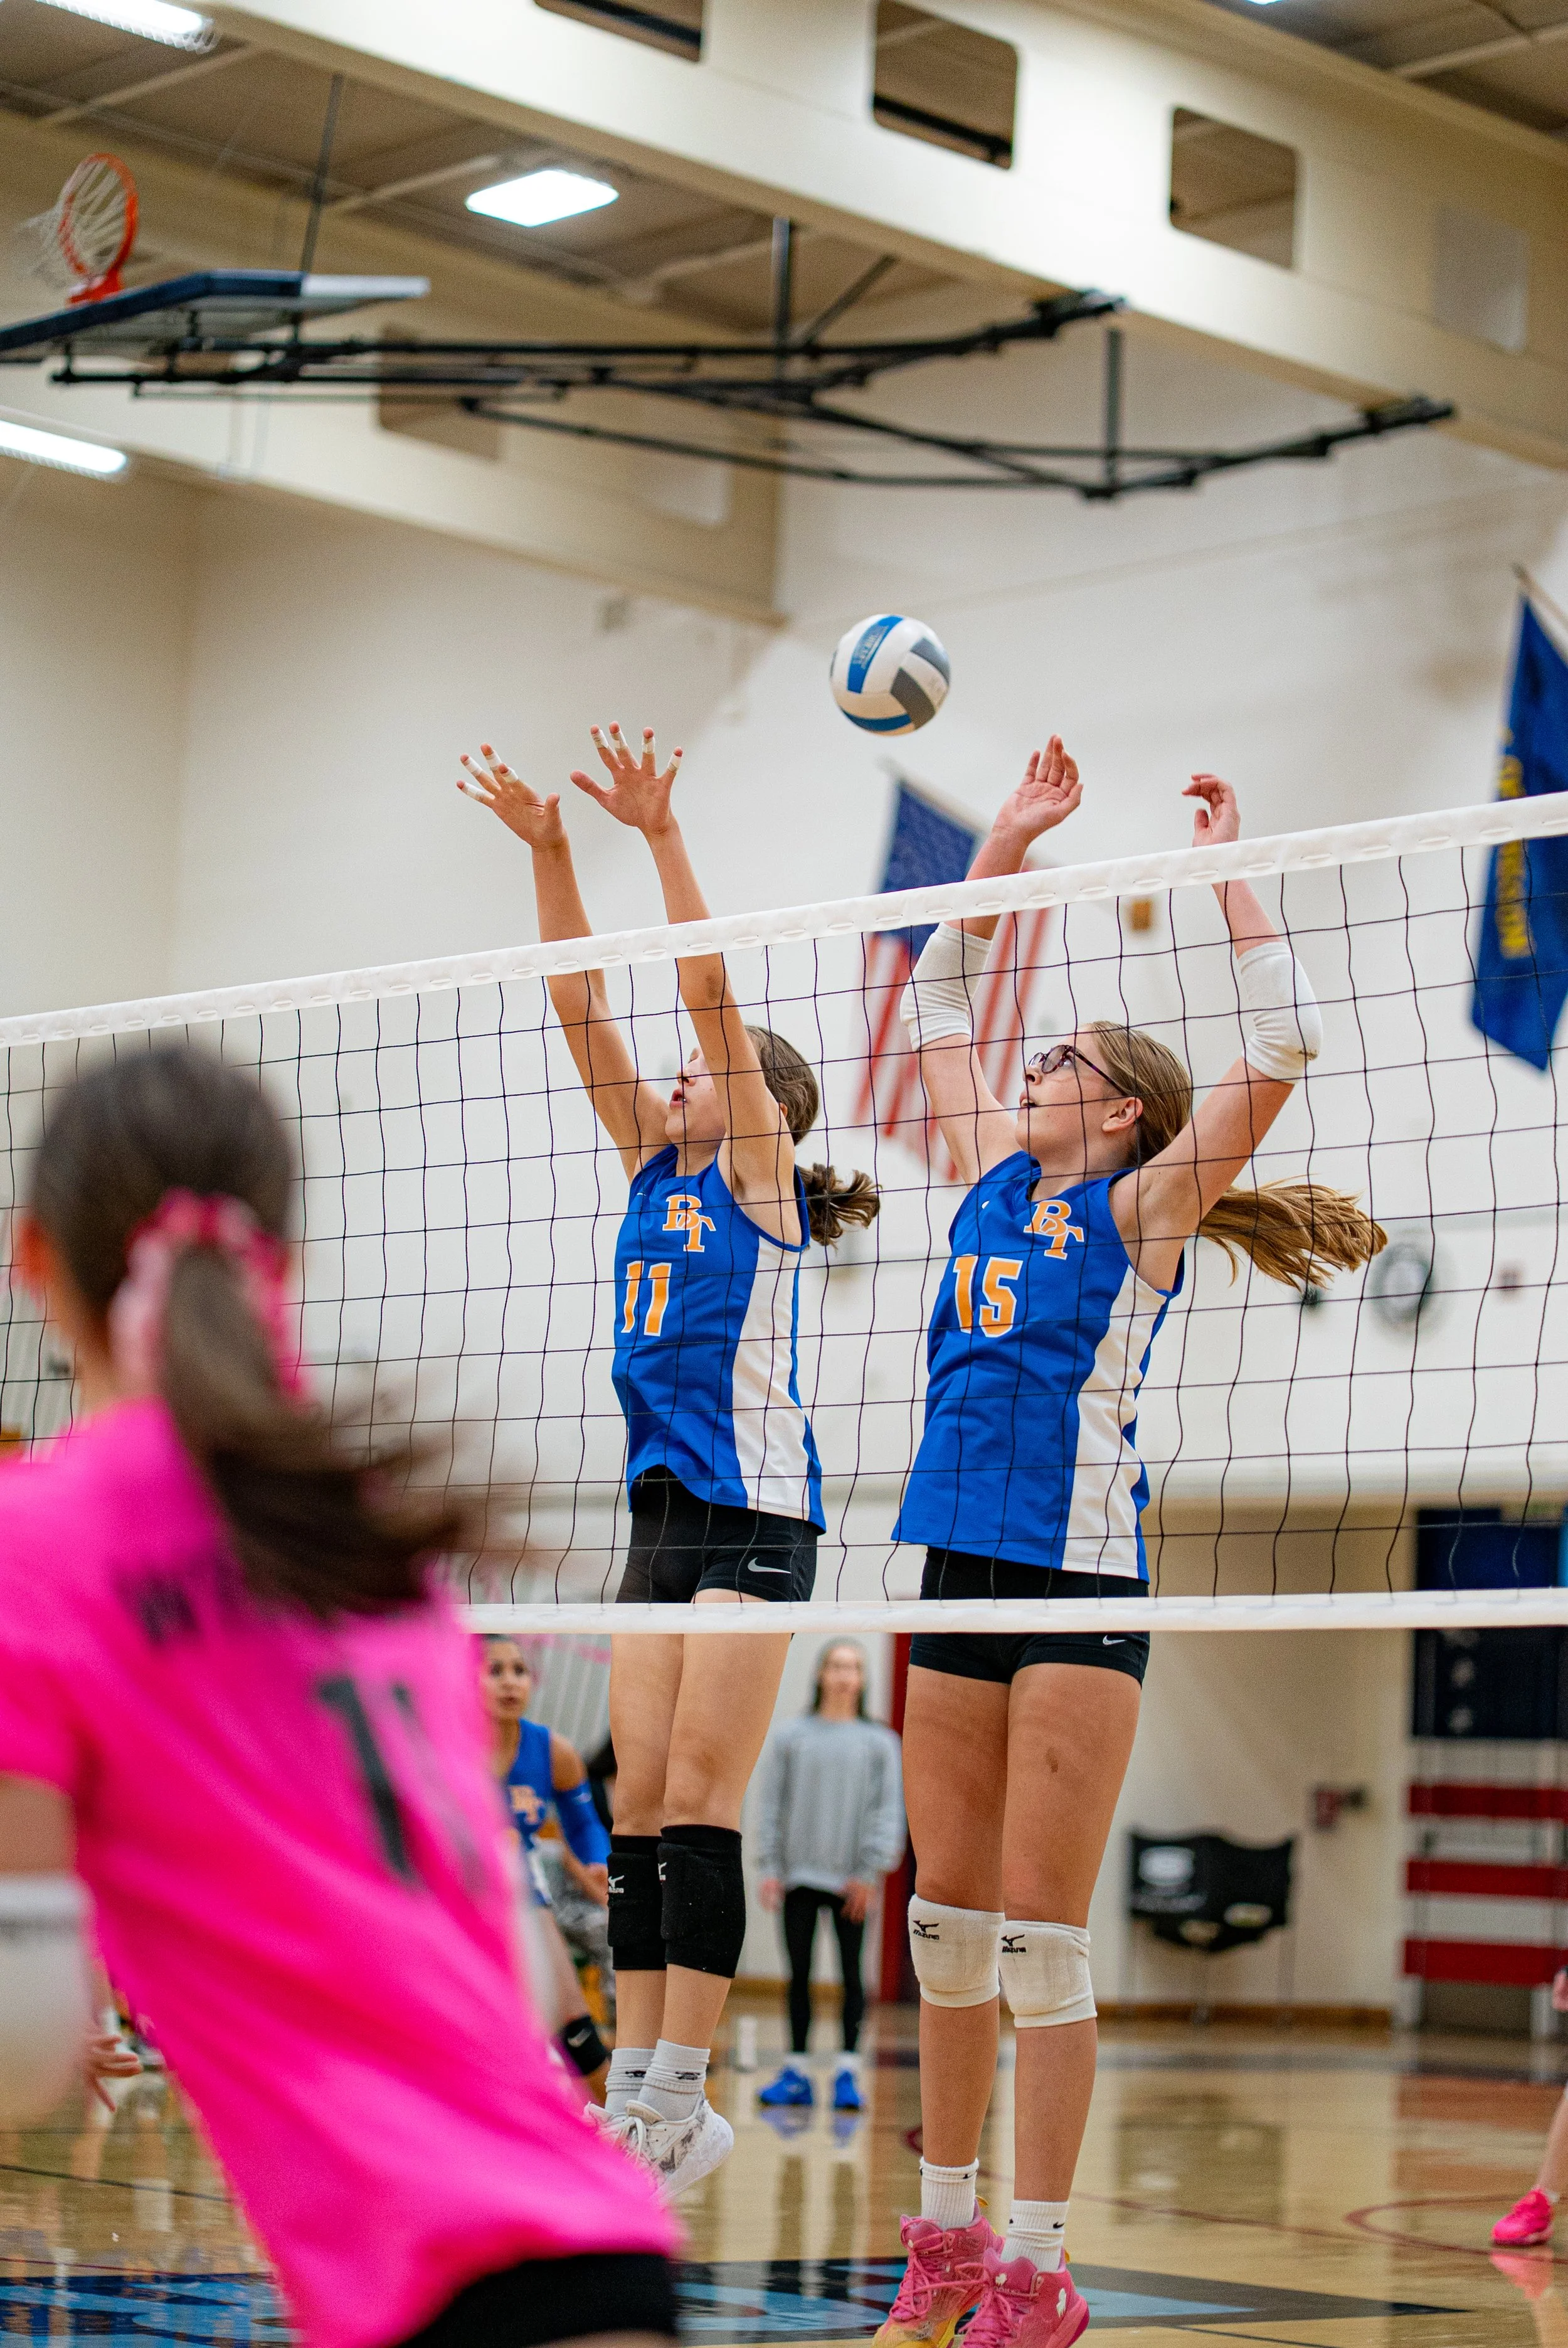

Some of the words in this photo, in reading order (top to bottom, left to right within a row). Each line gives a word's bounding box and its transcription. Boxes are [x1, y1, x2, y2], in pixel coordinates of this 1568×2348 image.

[662, 1194, 716, 1253] BT
[1023, 1199, 1084, 1260] BT
[620, 1260, 672, 1337] 11
[952, 1253, 1024, 1338] 15
